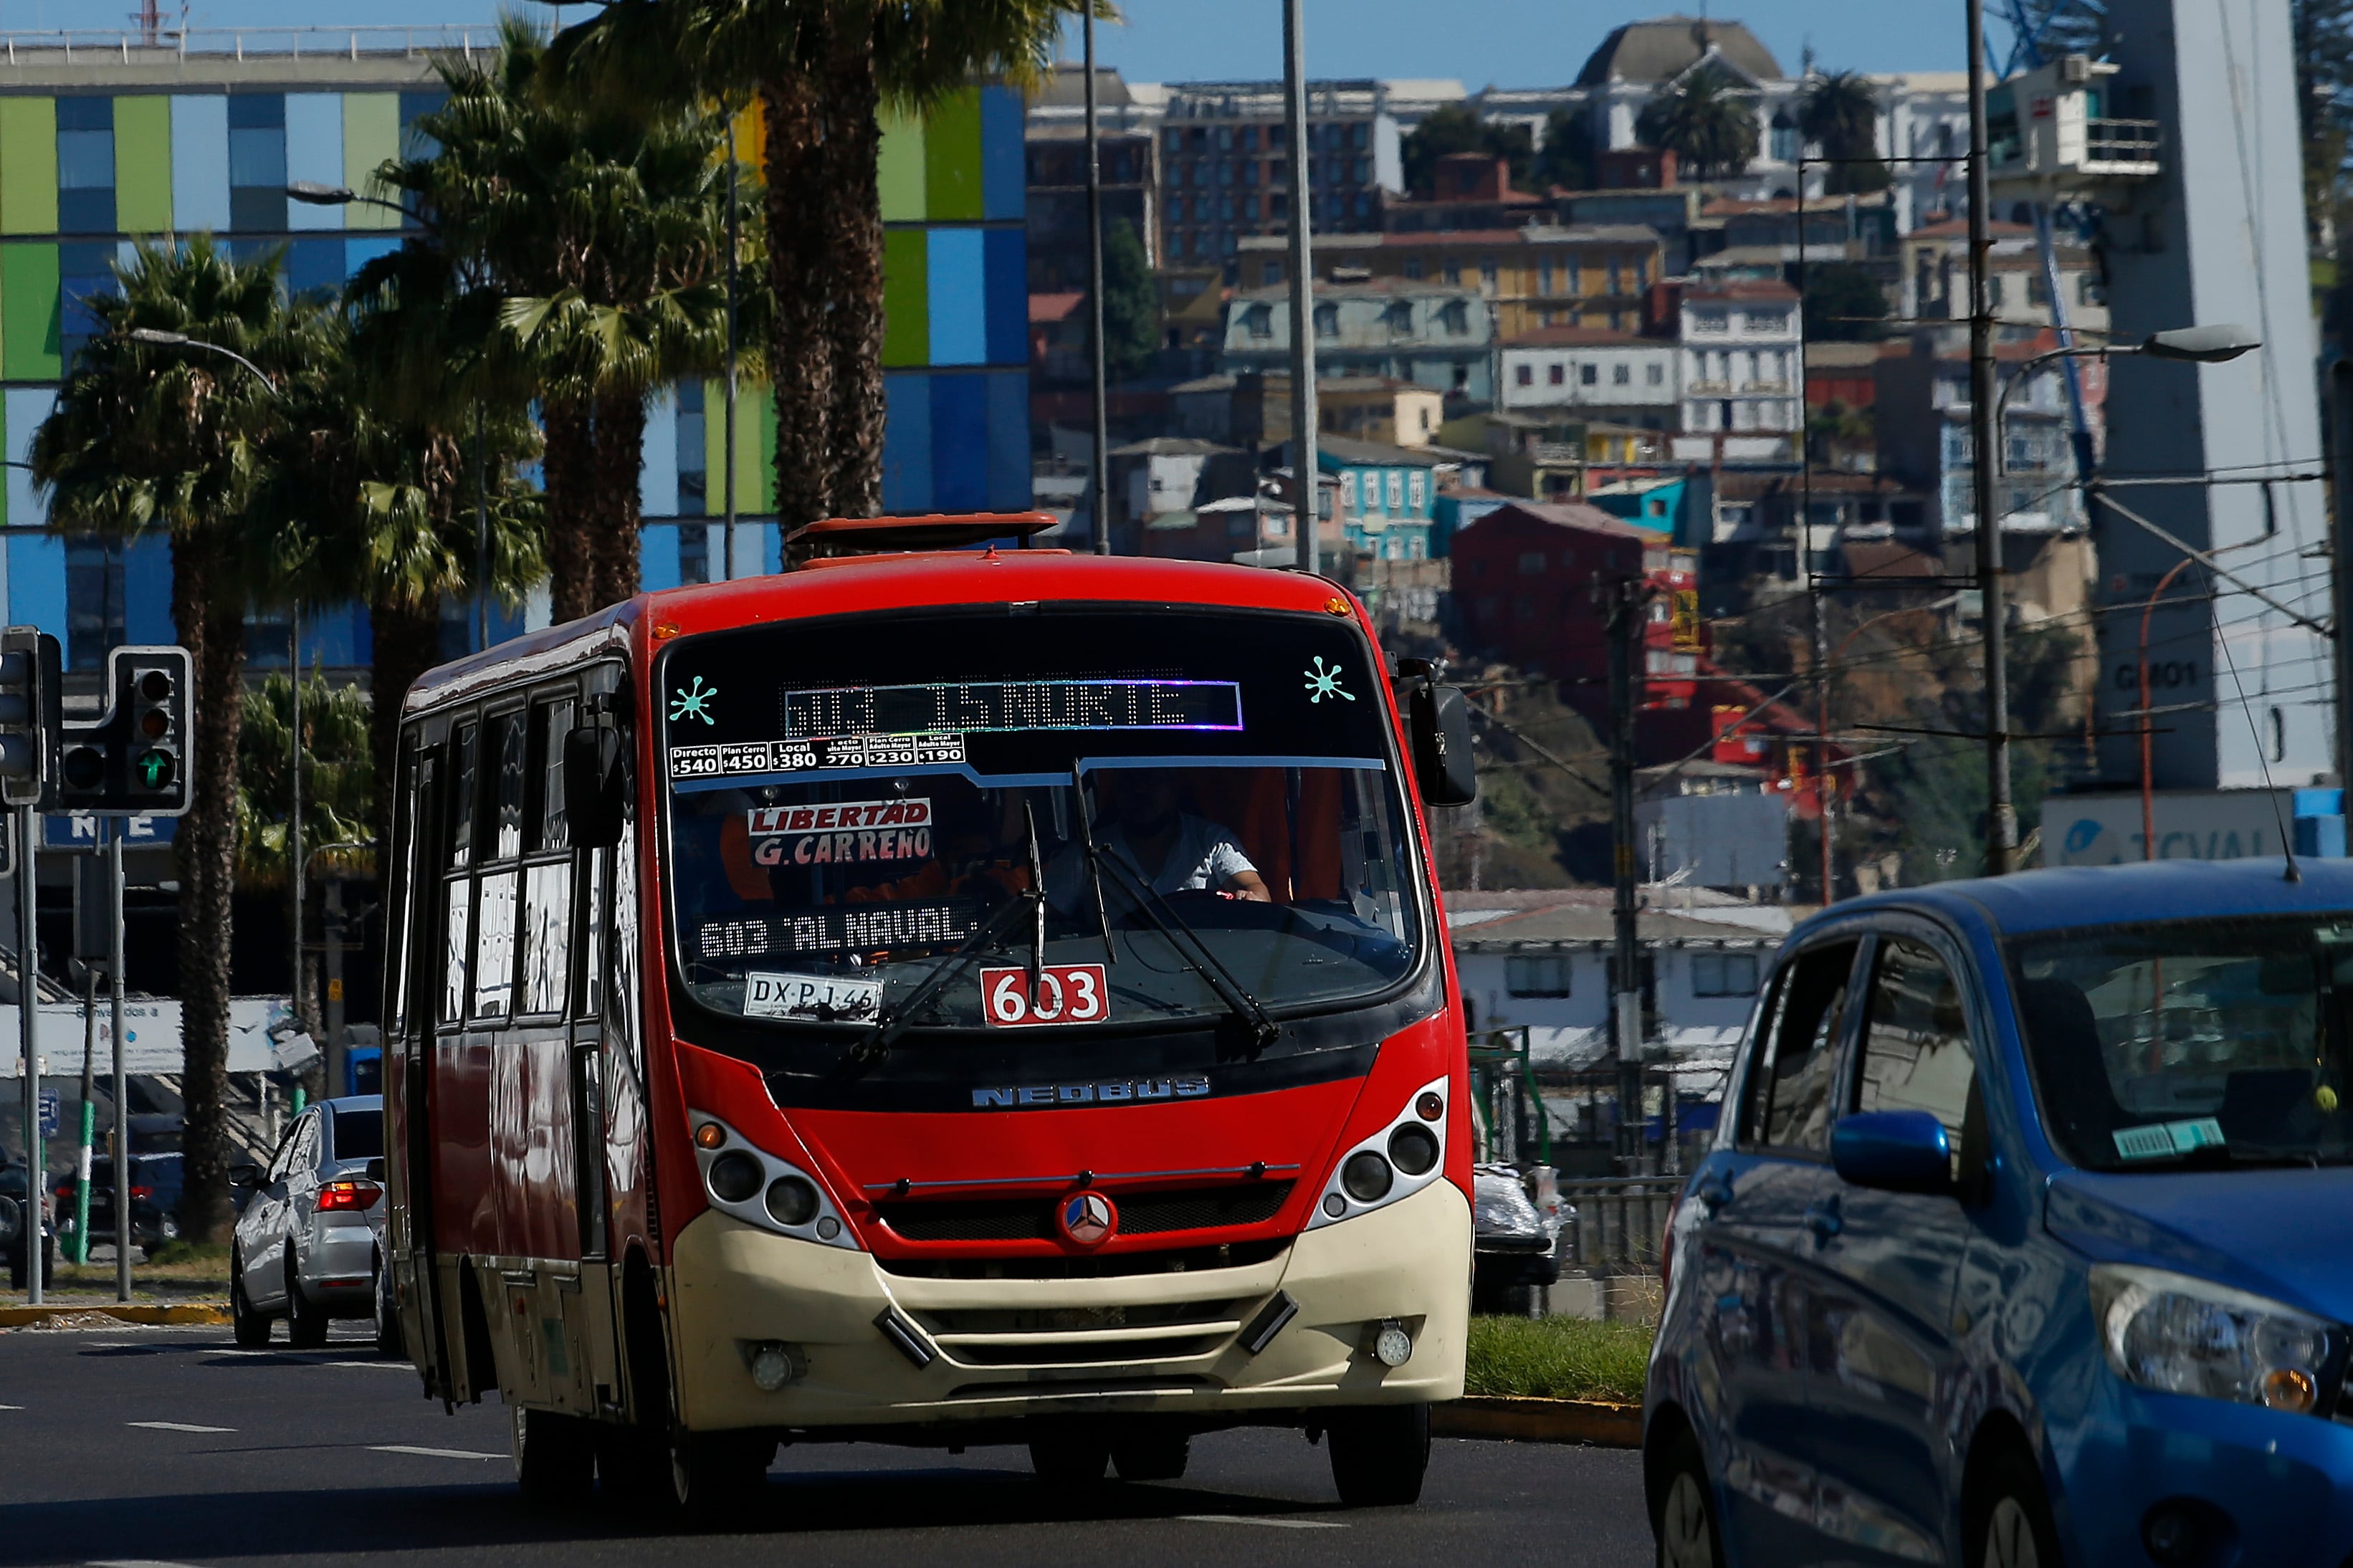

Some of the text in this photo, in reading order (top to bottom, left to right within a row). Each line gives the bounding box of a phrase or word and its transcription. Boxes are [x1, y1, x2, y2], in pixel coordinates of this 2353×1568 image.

[674, 748, 717, 758] Directo
[779, 742, 811, 752] Local
[723, 754, 766, 770] $450
[773, 752, 817, 768] $380
[869, 752, 912, 763] $230
[673, 758, 717, 774] $540
[751, 803, 929, 833] LIBERTAD
[701, 919, 767, 957] 603
[993, 971, 1100, 1022] 603
[972, 1076, 1211, 1107] NEOBUS
